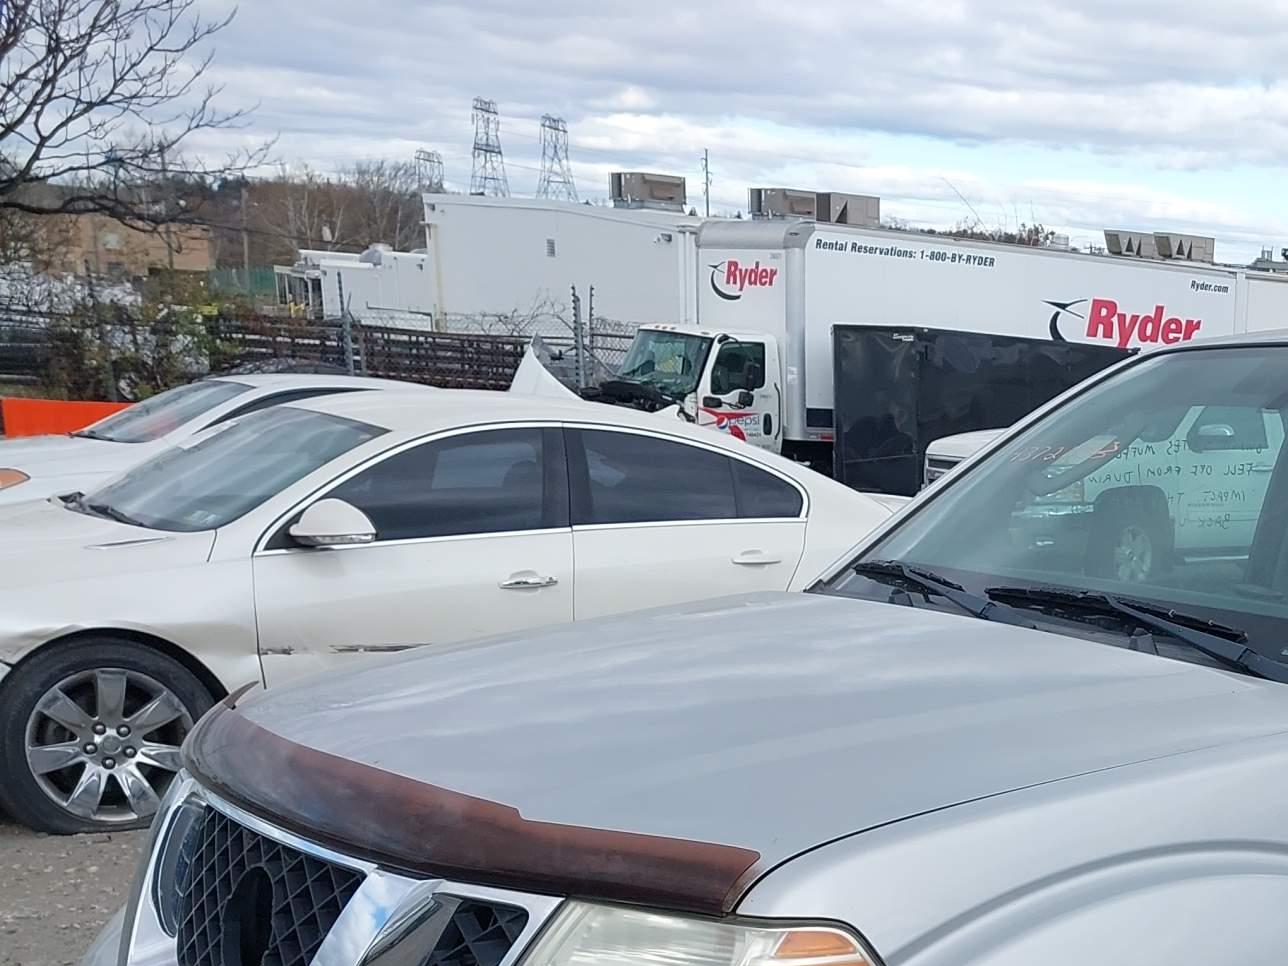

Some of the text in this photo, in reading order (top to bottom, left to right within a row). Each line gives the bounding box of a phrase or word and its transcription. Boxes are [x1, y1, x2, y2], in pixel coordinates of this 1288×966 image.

[815, 238, 996, 267] Rental Reservations: 1-800-BY-RYDER
[725, 260, 777, 291] Ryder
[1190, 280, 1229, 293] Ryder.com
[1086, 298, 1202, 350] Ryder
